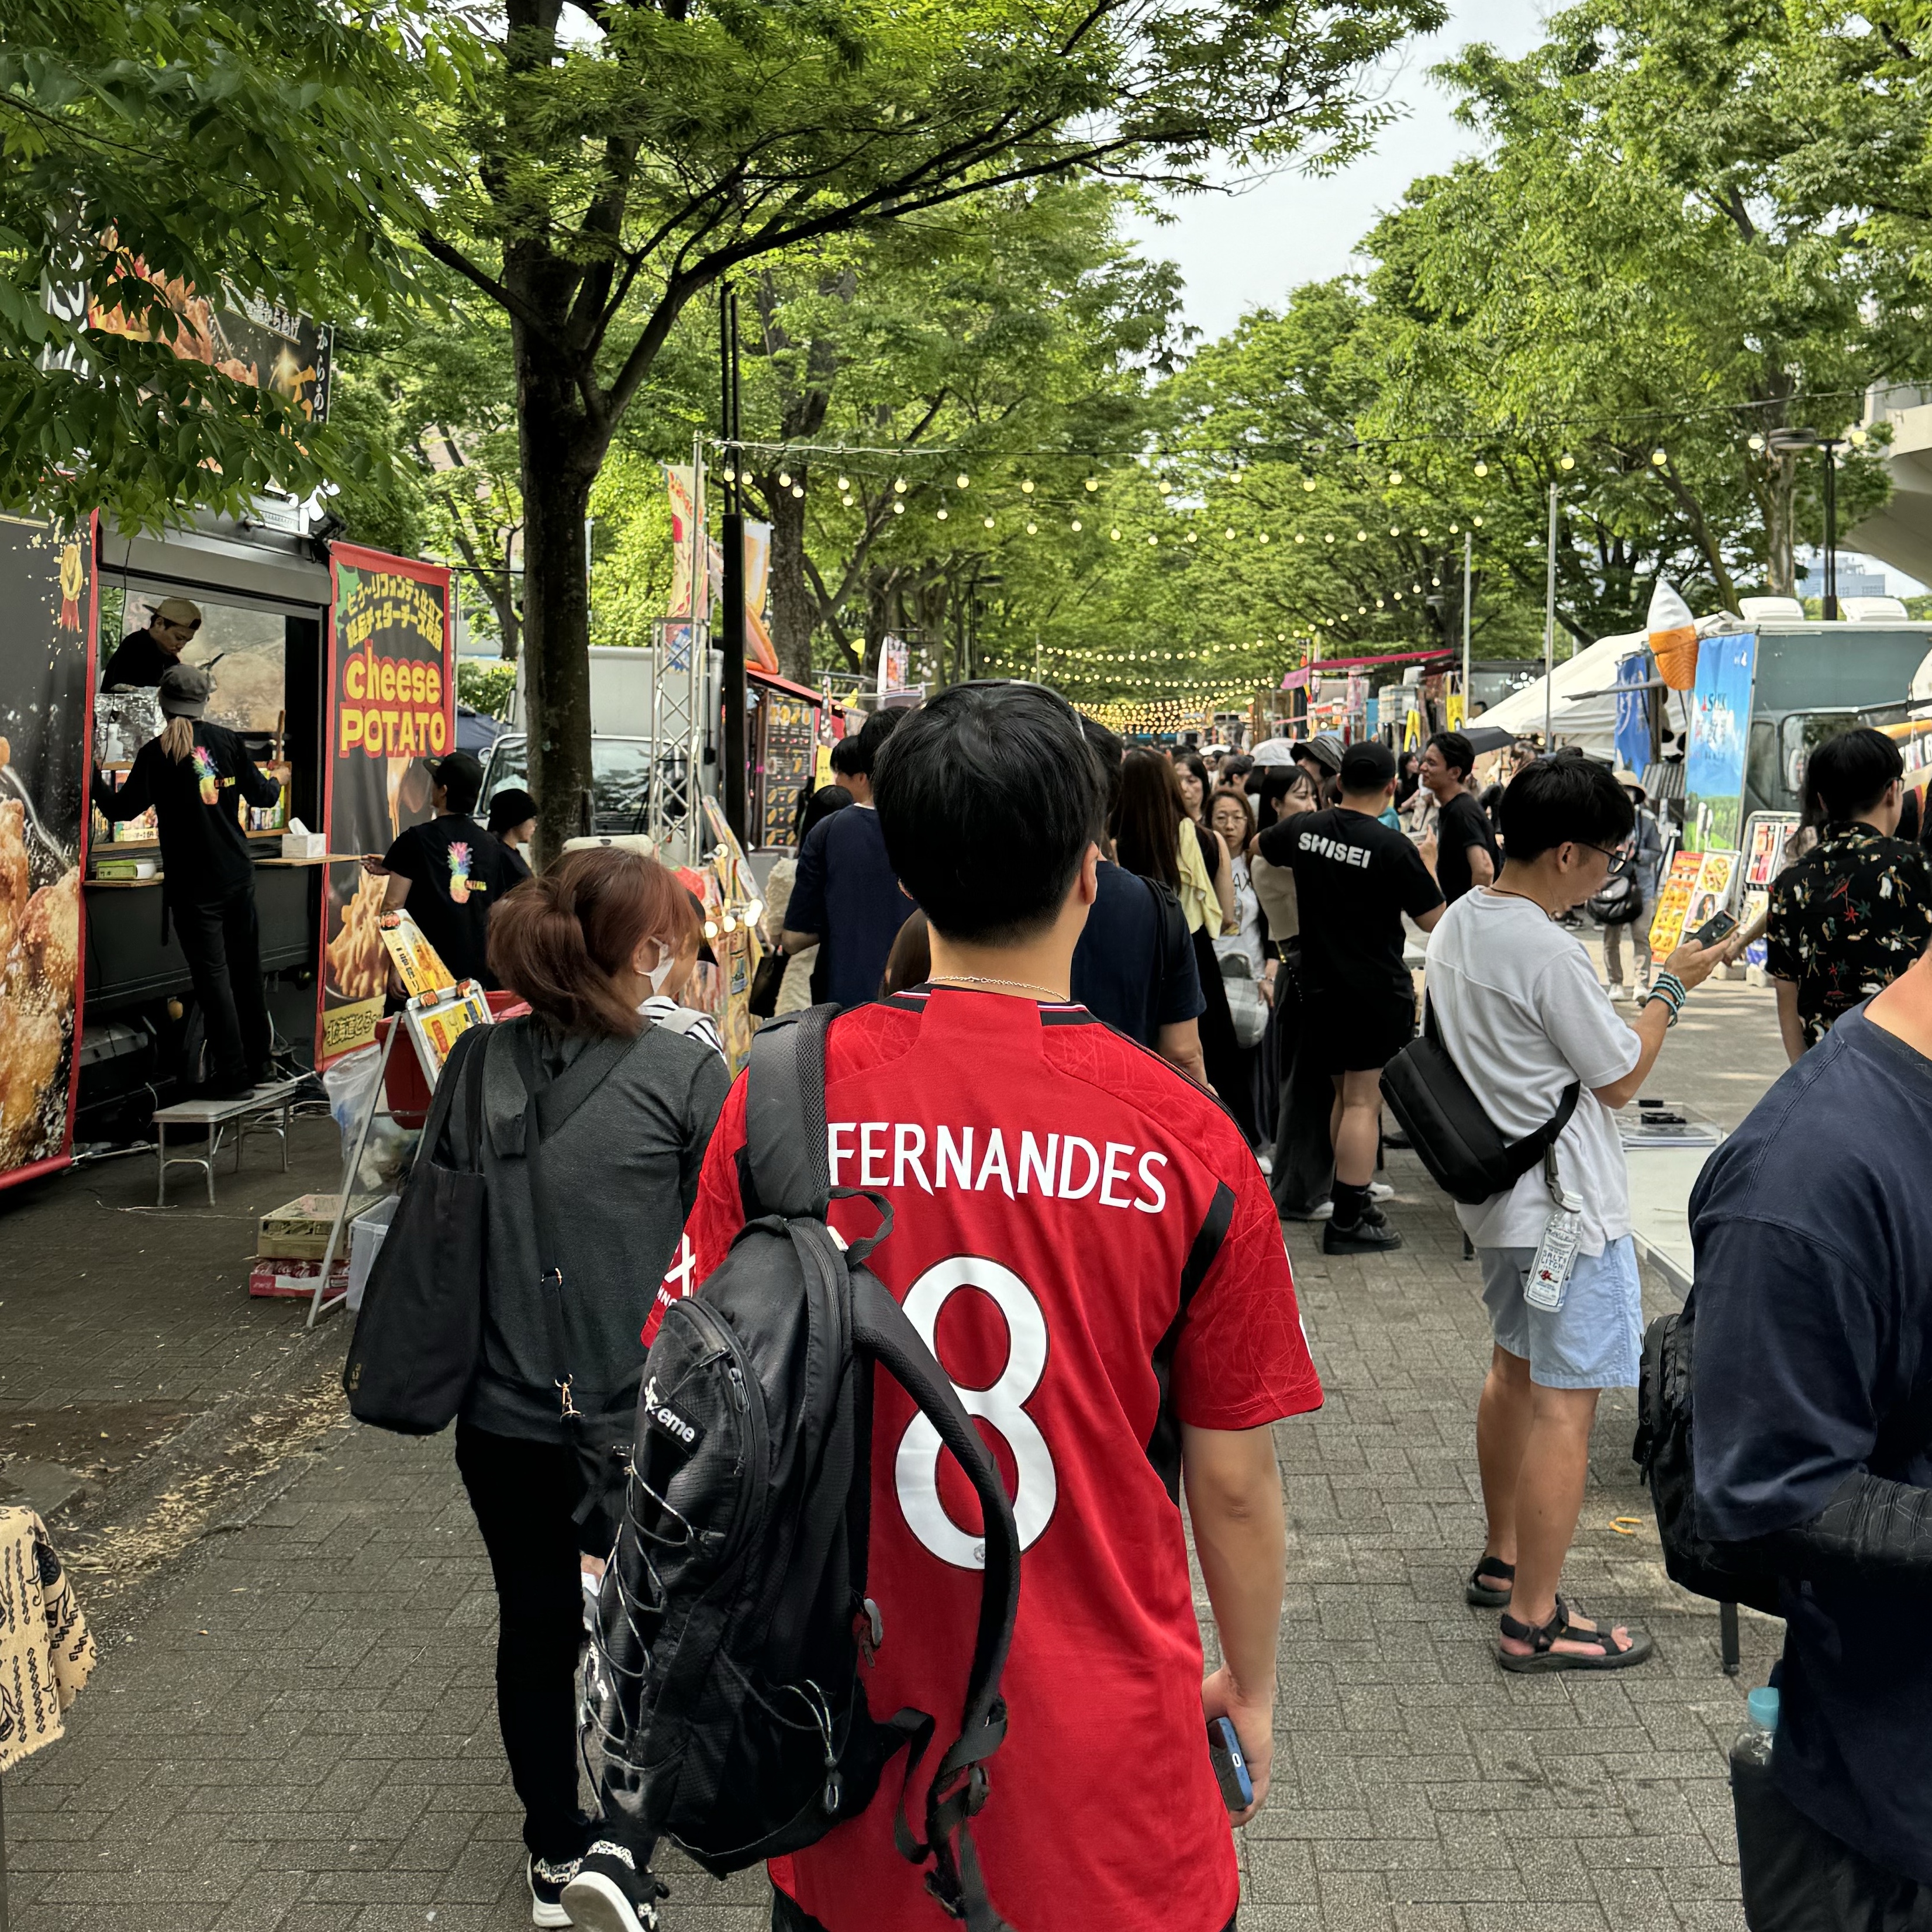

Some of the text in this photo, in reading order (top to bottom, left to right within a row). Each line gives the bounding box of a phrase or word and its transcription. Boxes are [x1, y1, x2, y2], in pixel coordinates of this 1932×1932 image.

[346, 646, 441, 705] cheese
[341, 708, 446, 752] POTATO
[1298, 832, 1372, 870] SHISEI
[827, 1122, 1168, 1214] FERNANDES
[893, 1253, 1058, 1572] 8
